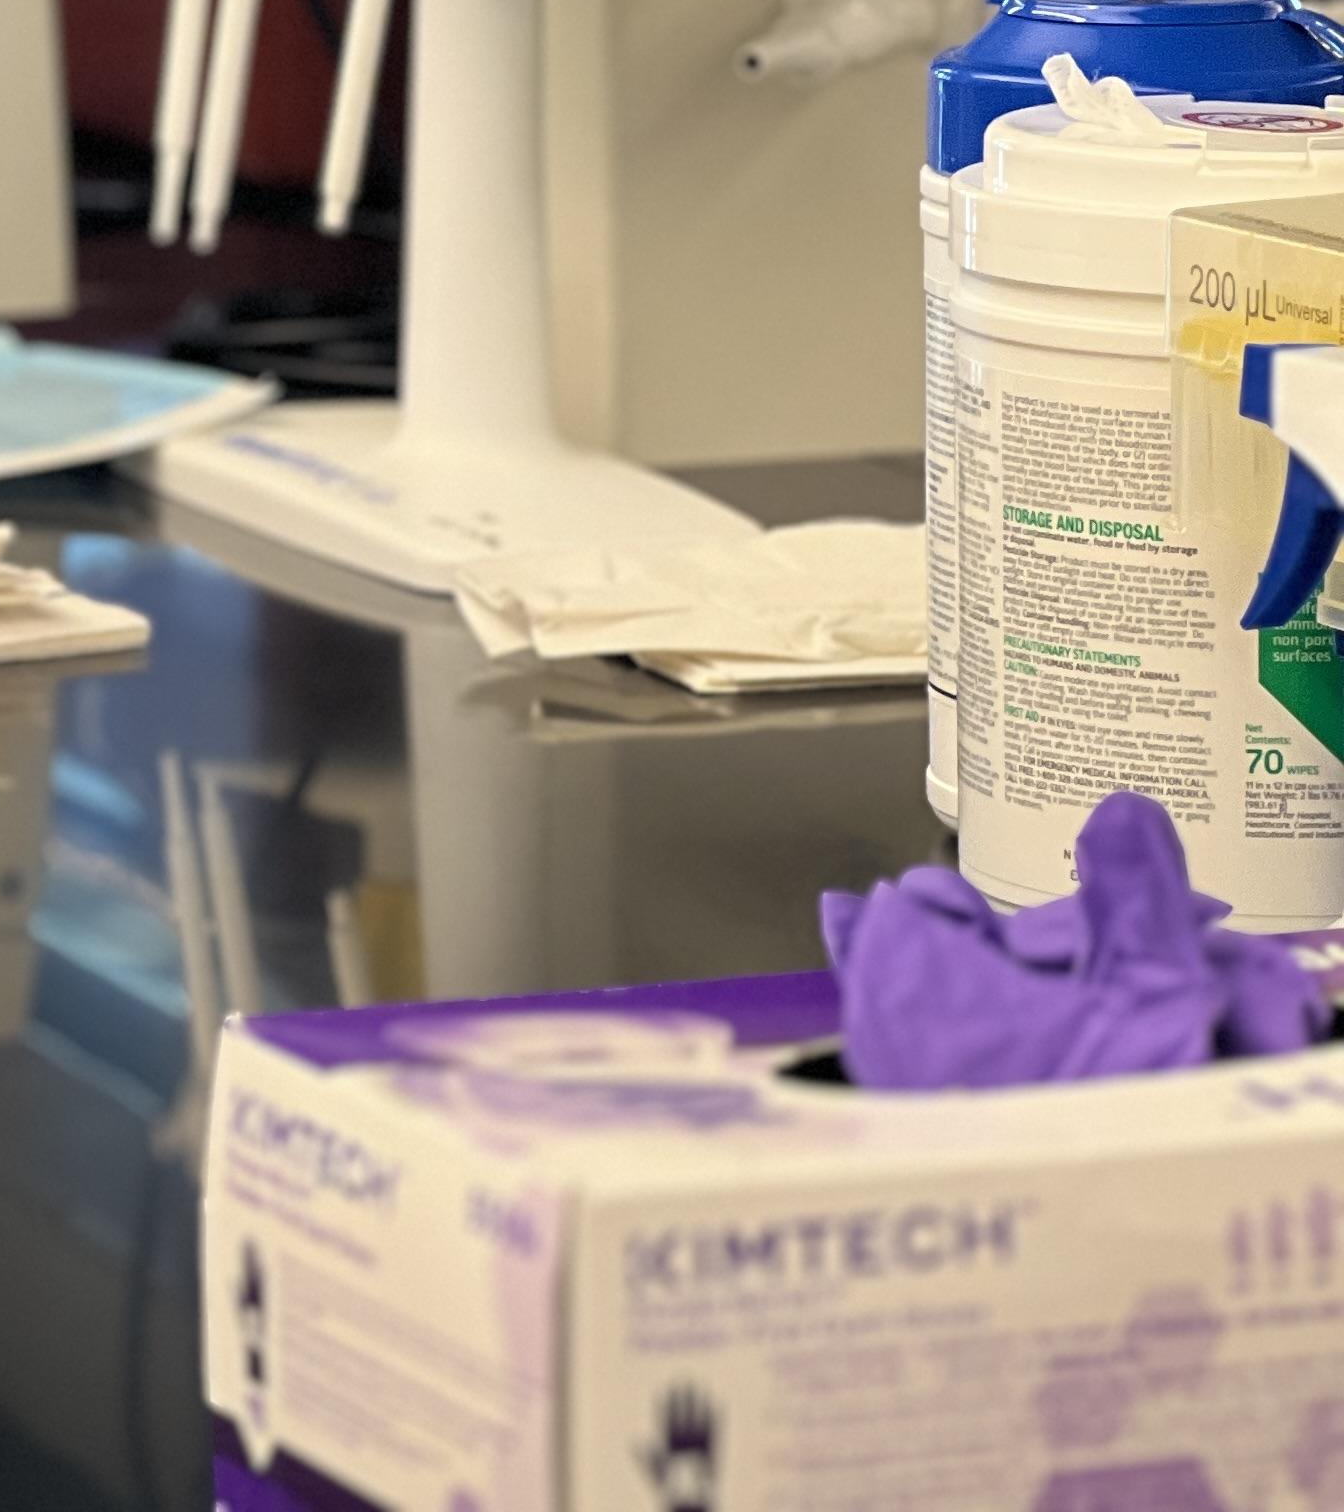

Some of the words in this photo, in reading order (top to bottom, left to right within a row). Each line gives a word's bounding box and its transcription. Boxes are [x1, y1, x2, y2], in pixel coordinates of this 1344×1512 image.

[1189, 264, 1236, 312] 200
[1275, 294, 1333, 326] Universal
[1003, 504, 1052, 529] STORAGE
[1056, 515, 1084, 533] AND
[1089, 519, 1164, 541] DISPOSAL
[1115, 541, 1124, 549] or
[1127, 541, 1146, 551] feed
[1147, 543, 1159, 555] by
[1162, 545, 1198, 557] storage
[1170, 568, 1184, 579] dry
[1184, 579, 1209, 587] direct
[1004, 635, 1071, 658] PRECAUTIONARY
[1073, 648, 1141, 667] STATEMENTS
[1273, 650, 1332, 663] surfaces
[1076, 663, 1092, 673] AND
[1094, 665, 1137, 678] DOMESTIC
[1139, 670, 1180, 682] ANIMALS
[1184, 689, 1216, 698] contact
[1025, 710, 1039, 723] AID
[1245, 724, 1263, 732] Net
[1176, 734, 1205, 745] slowly
[1245, 735, 1292, 745] Contents:
[1245, 749, 1284, 775] 70
[1286, 765, 1319, 775] WIPES
[1119, 772, 1182, 786] INFORMATION
[1184, 777, 1206, 788] CALL
[1133, 785, 1163, 795] NORTH
[622, 1205, 1018, 1288] KIMTECH
